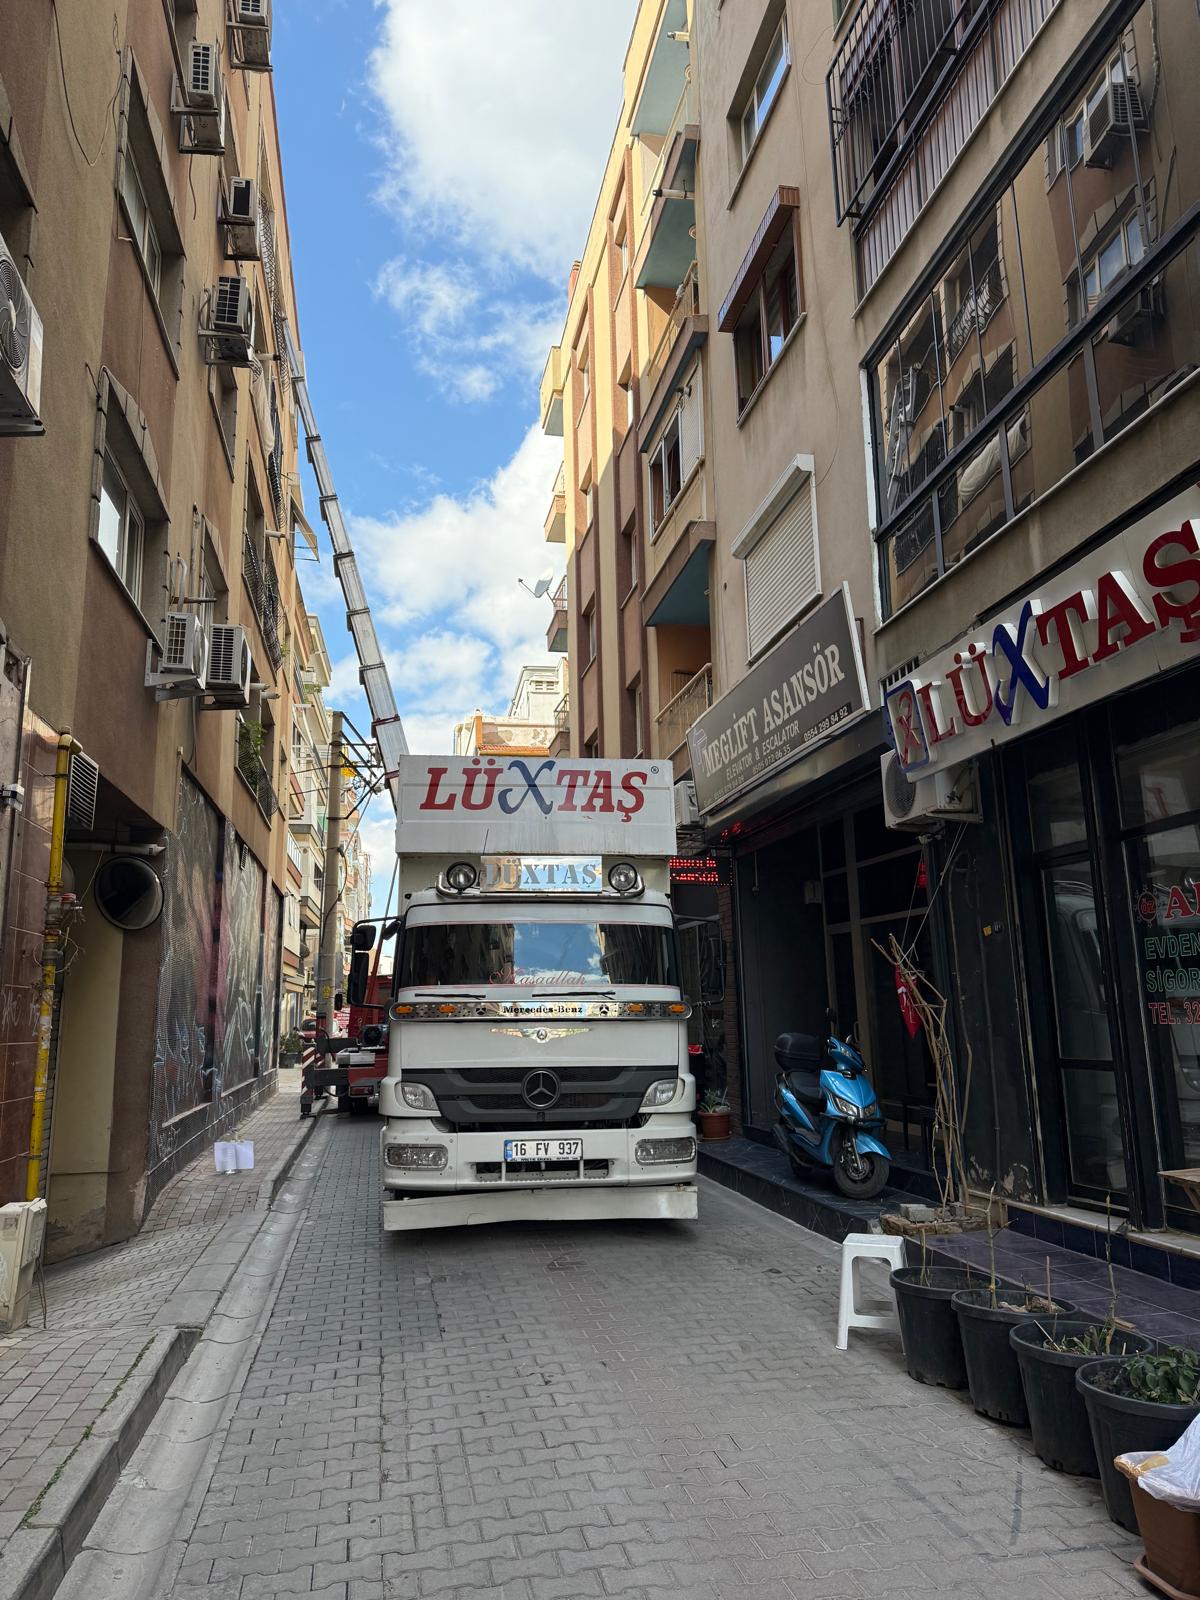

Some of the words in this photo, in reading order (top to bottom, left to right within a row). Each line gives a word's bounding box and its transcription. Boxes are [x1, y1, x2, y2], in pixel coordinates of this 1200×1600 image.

[703, 713, 758, 778] MEGLİFT
[763, 642, 845, 734] ASANSÖR
[839, 706, 849, 718] 92
[726, 752, 752, 780] ELEVATOR
[755, 749, 761, 761] &
[762, 720, 800, 755] ESCALATOR
[419, 757, 648, 823] LÜXTAŞ
[503, 1004, 583, 1014] Mercedes-Benz
[513, 1142, 527, 1156] 16
[535, 1142, 550, 1156] FV
[558, 1141, 579, 1155] 937
